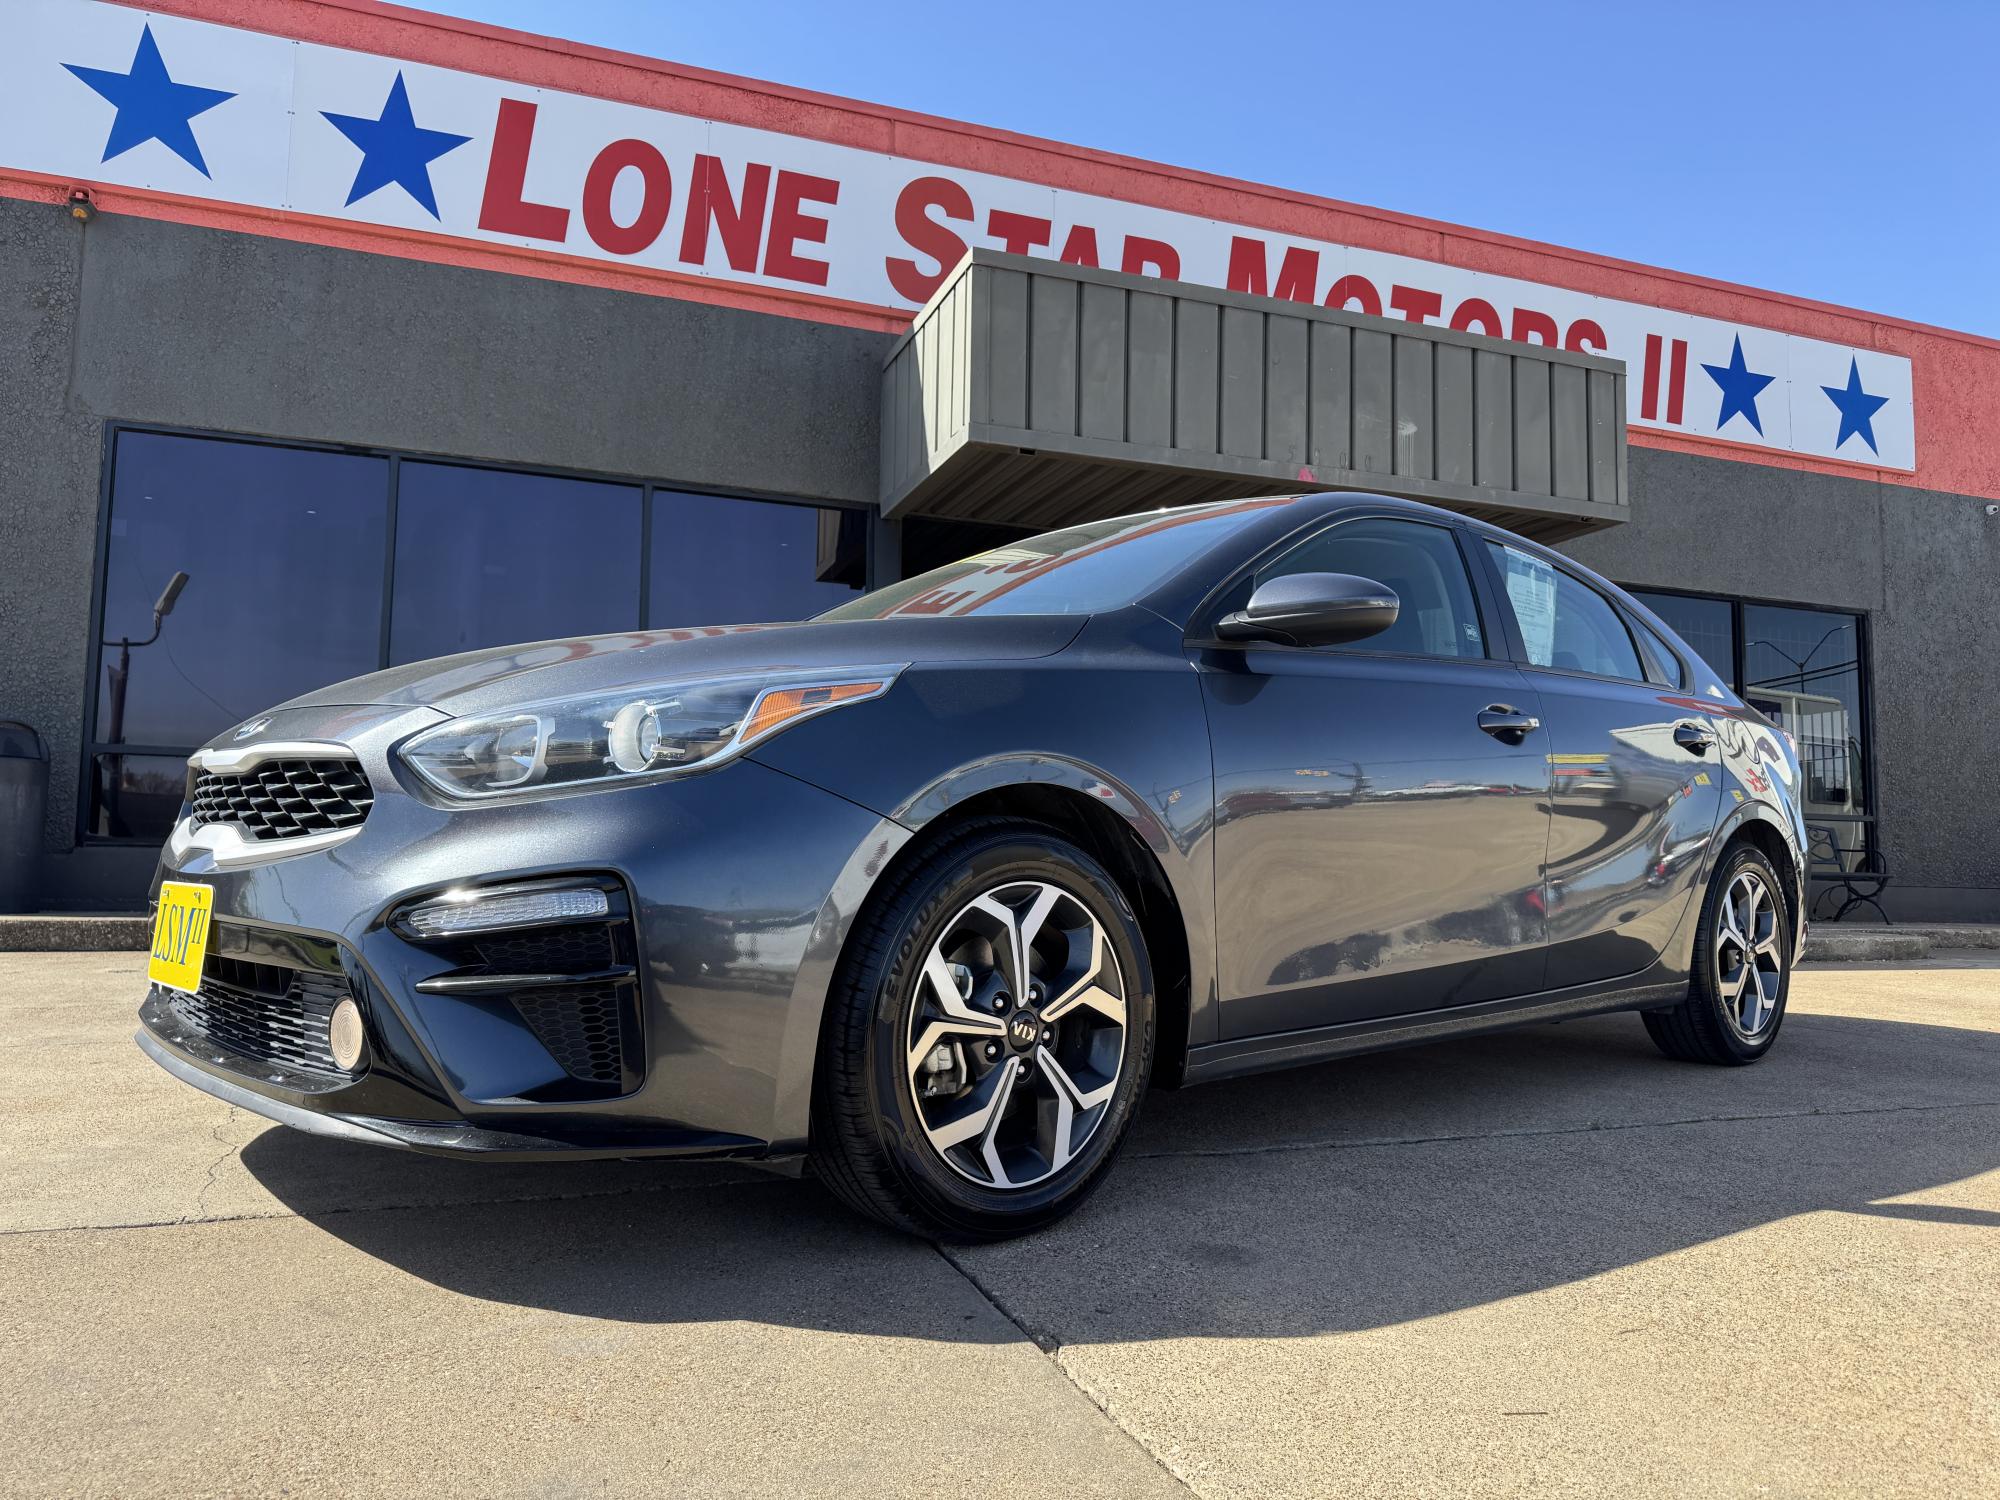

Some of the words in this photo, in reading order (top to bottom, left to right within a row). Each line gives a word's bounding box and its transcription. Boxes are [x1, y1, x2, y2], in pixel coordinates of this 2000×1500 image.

[477, 97, 840, 287] LONE
[1641, 333, 1688, 425] II
[1012, 1020, 1037, 1042] KIA
